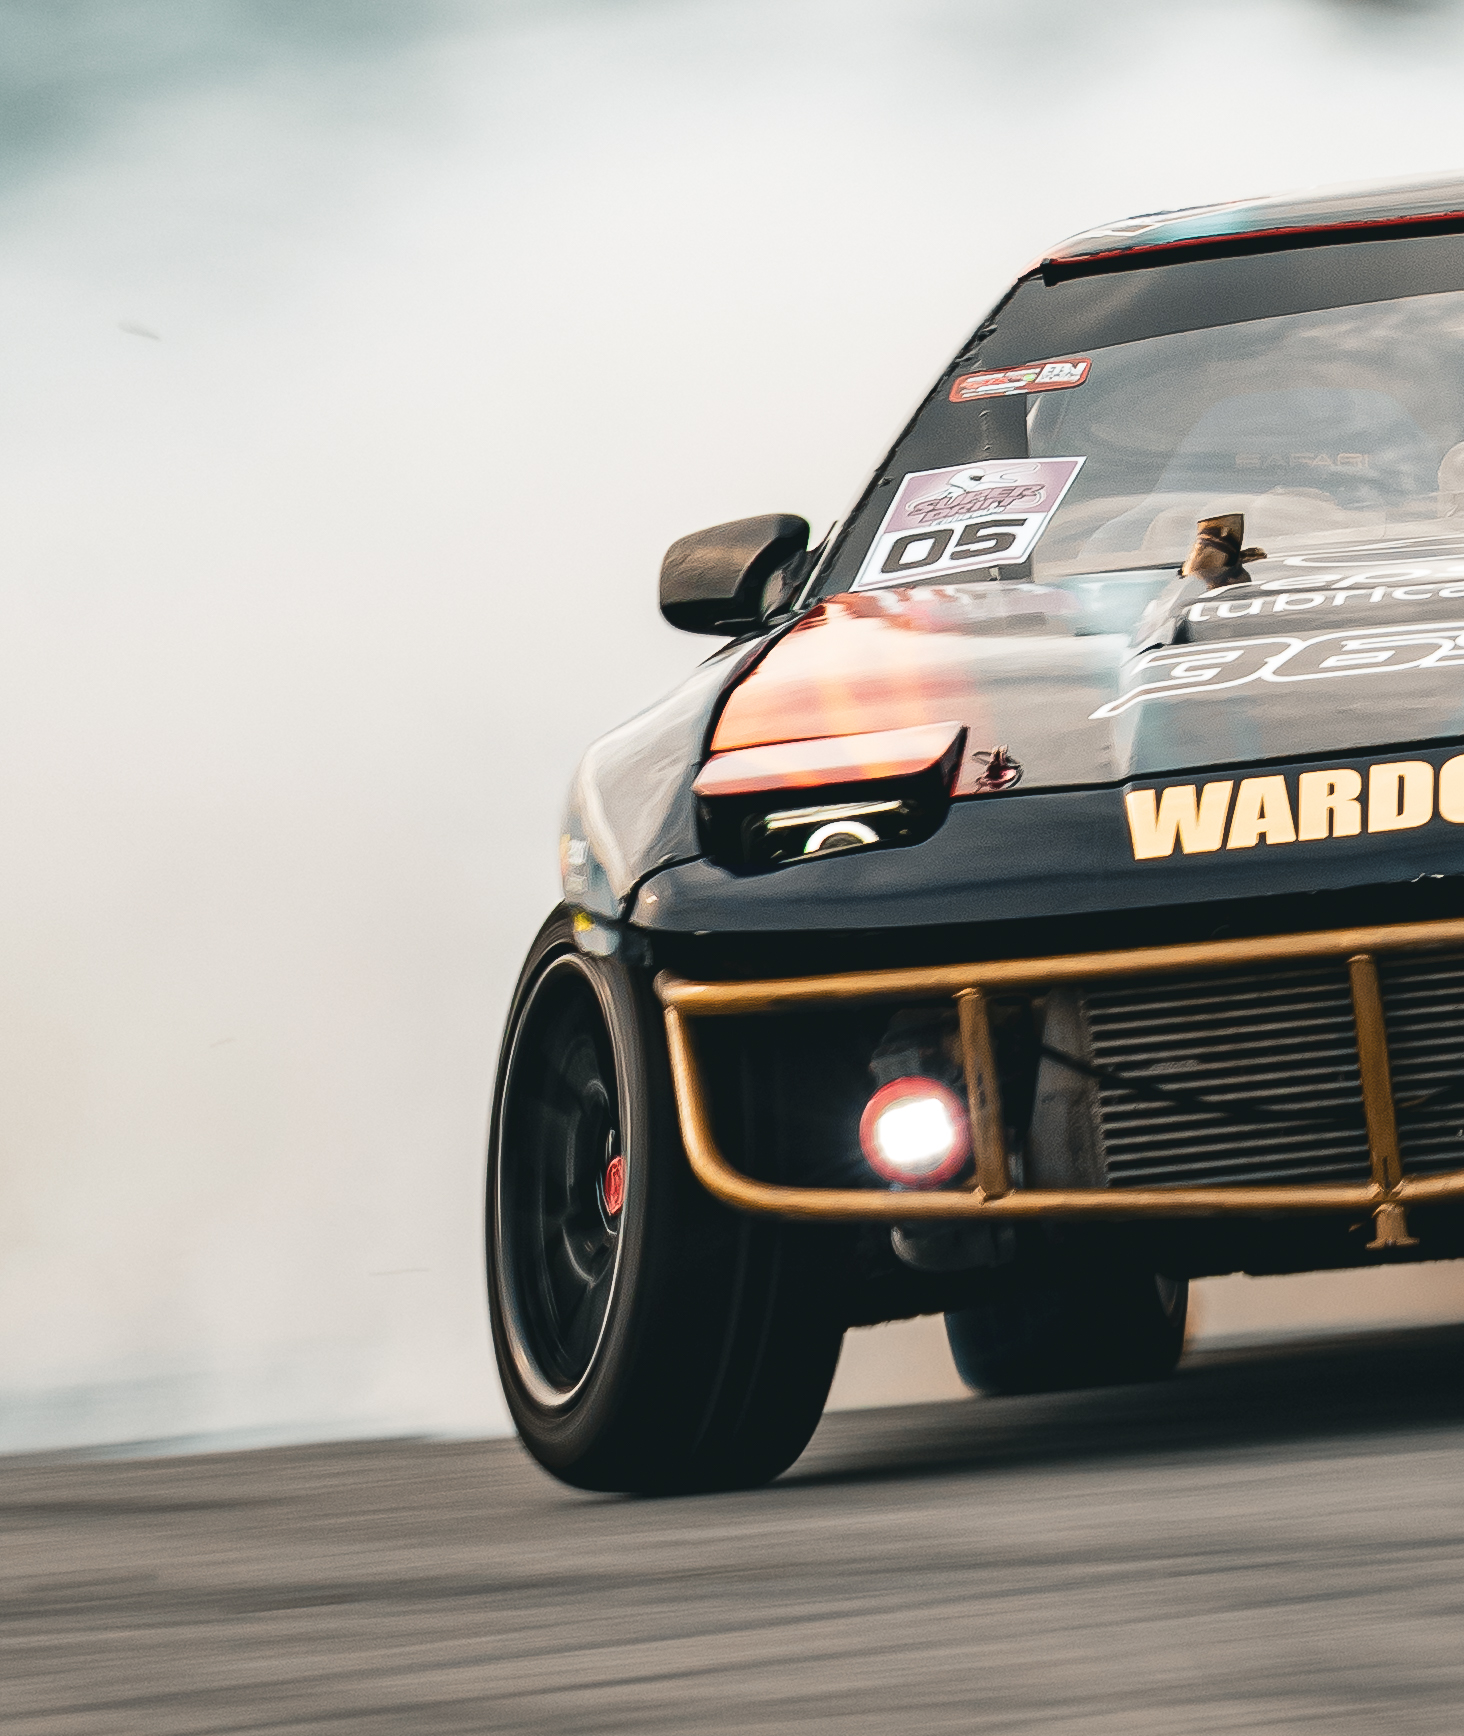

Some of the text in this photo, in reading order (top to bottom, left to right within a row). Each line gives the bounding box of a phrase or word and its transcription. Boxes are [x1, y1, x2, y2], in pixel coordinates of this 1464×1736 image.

[907, 484, 1045, 517] SUPER
[918, 495, 1018, 524] DRIFT
[881, 517, 1028, 574] 05
